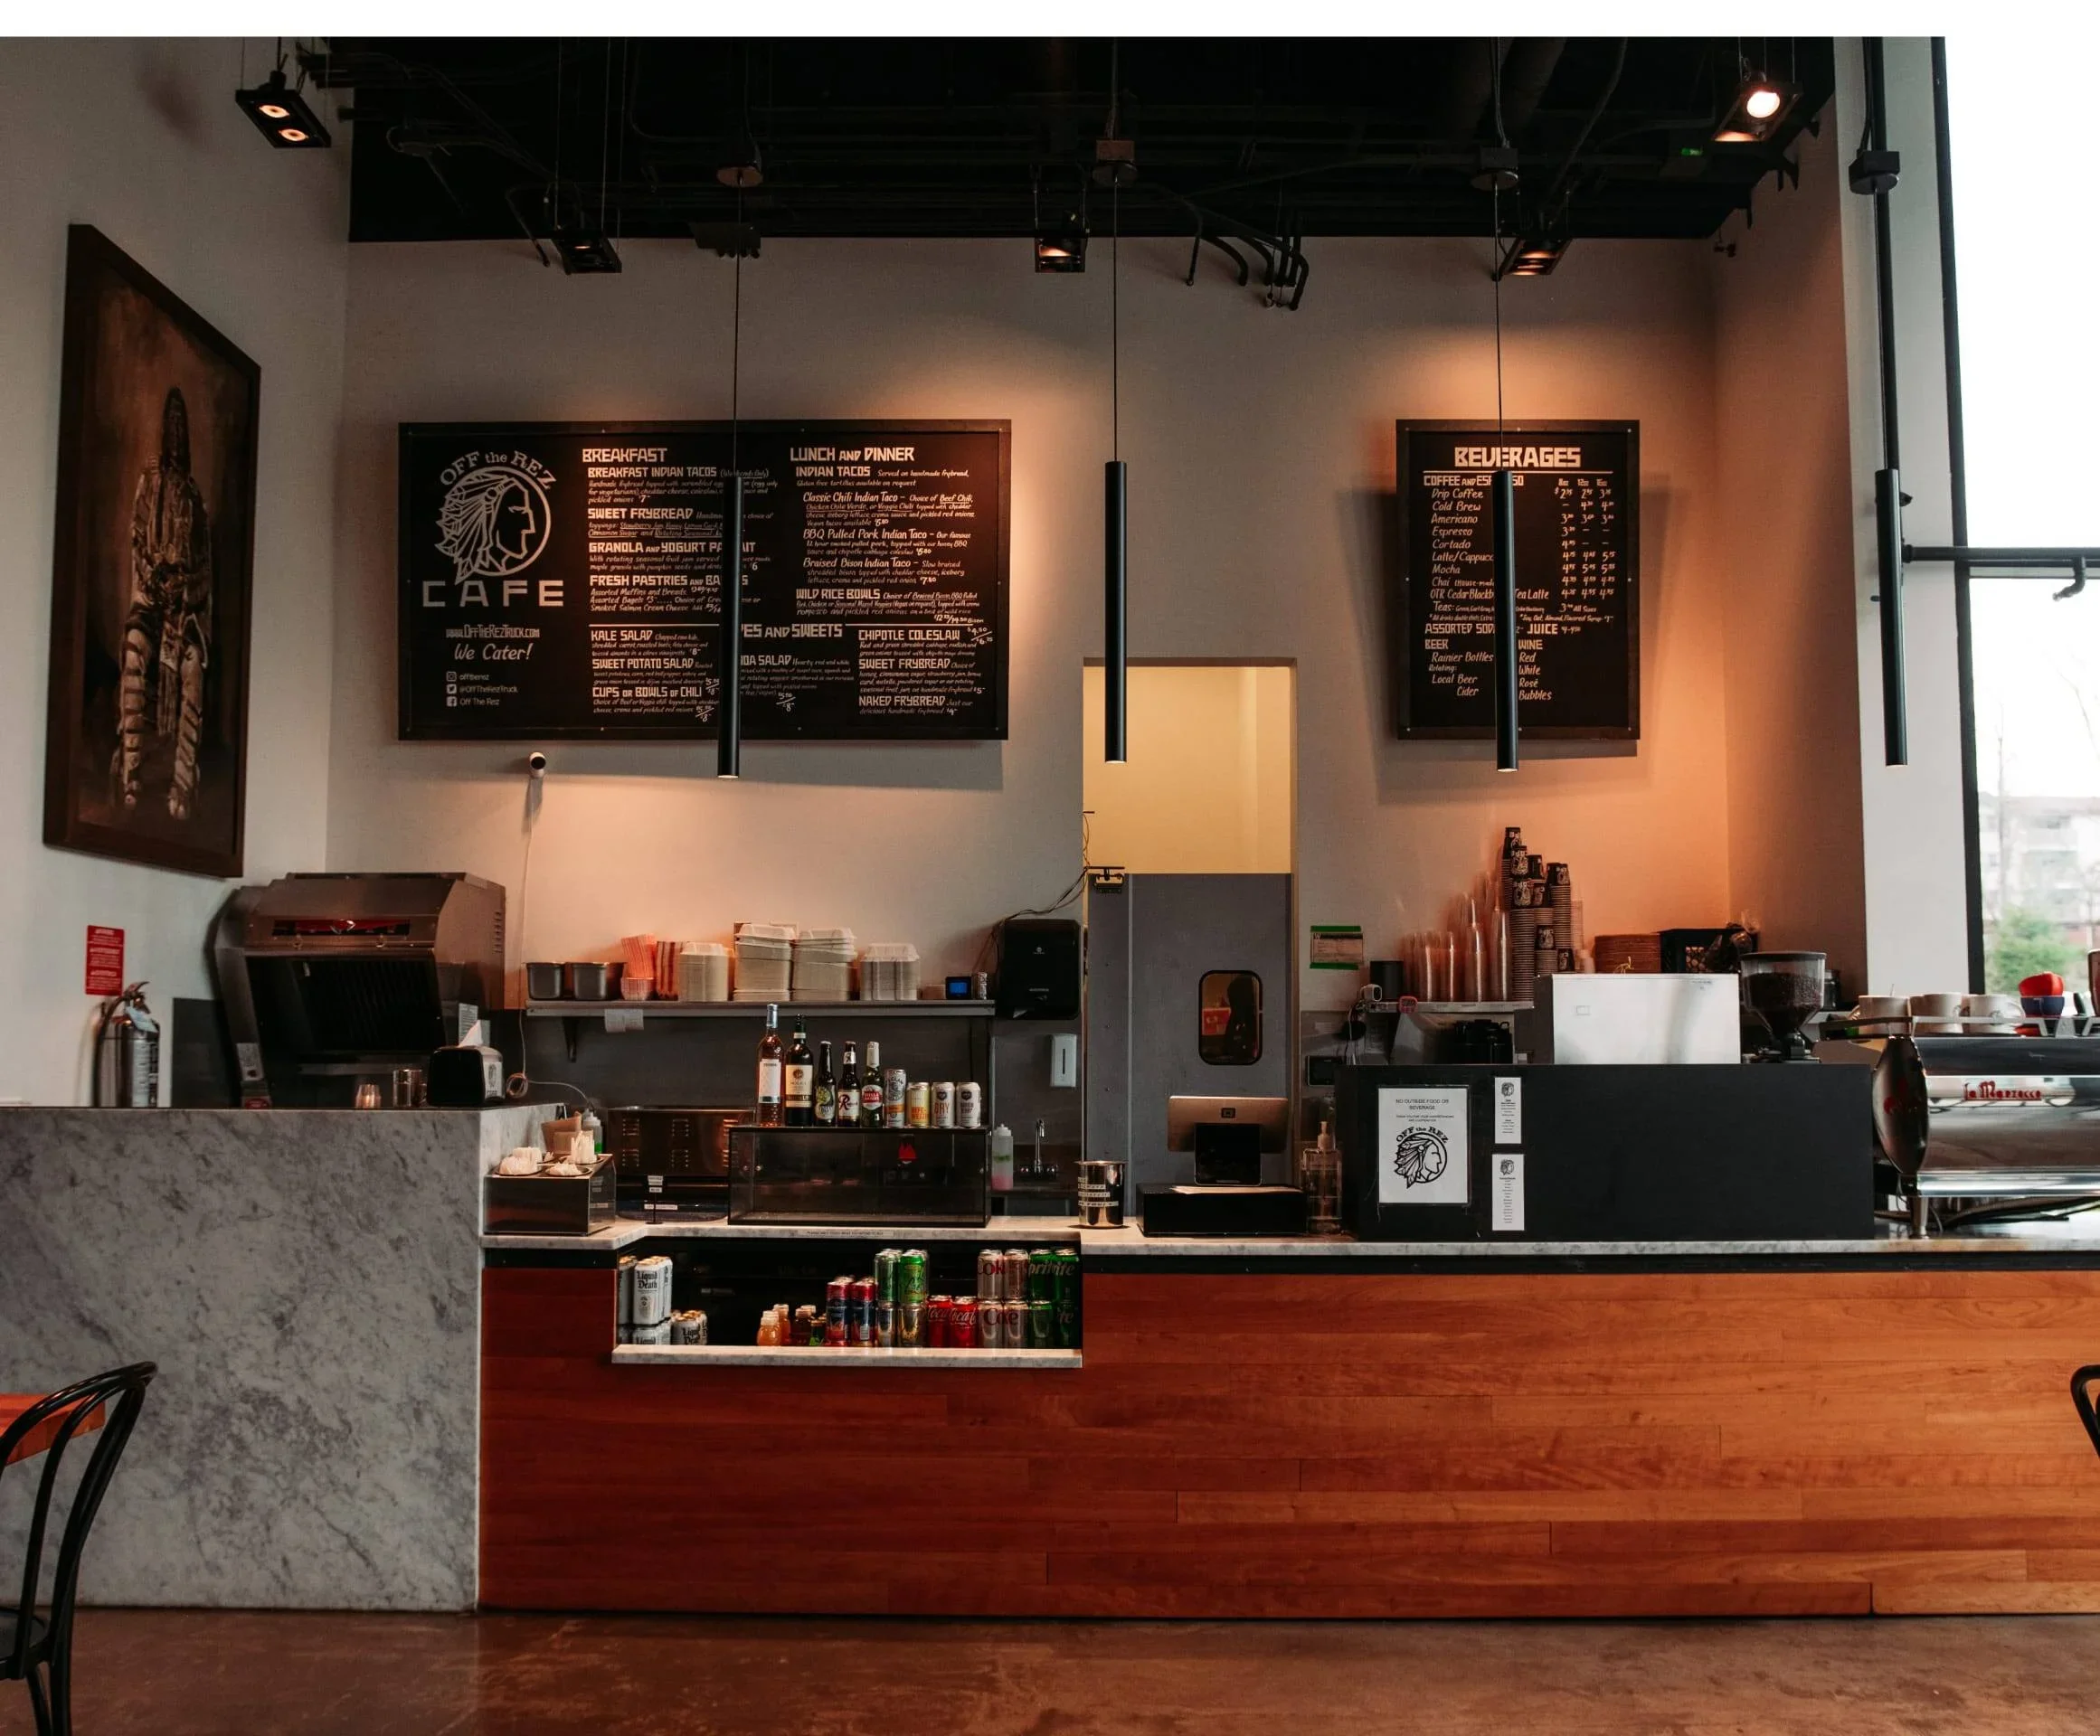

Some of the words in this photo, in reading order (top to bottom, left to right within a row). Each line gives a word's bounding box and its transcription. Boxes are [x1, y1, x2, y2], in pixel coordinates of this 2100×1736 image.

[582, 448, 667, 462] BREAKFAST
[790, 447, 835, 461] LUNCH
[839, 450, 861, 461] AND
[864, 447, 915, 461] DINNER
[1454, 447, 1581, 467] BEVERAGES
[440, 451, 479, 486] OFF
[484, 451, 507, 463] the
[510, 450, 557, 490] REZ
[588, 467, 648, 477] BREAKFAST
[651, 467, 684, 477] INDIAN
[686, 467, 717, 477] TACOS
[796, 466, 834, 476] INDIAN
[837, 466, 871, 476] TACOS
[877, 469, 900, 477] Served
[893, 479, 917, 488] request
[1424, 475, 1461, 486] COFFEE
[803, 491, 831, 502] Classic
[833, 491, 853, 502] Chili
[855, 491, 879, 502] Indian
[880, 490, 898, 503] Taco
[909, 494, 929, 502] Choice
[940, 494, 957, 503] Beef
[1432, 488, 1450, 500] Drip
[1452, 487, 1484, 498] Coffee
[1432, 501, 1452, 512] Cold
[1456, 501, 1481, 512] Brew
[588, 507, 628, 519] SWEET
[630, 507, 694, 519] FRYBREAD
[1431, 513, 1478, 524] Americano
[803, 528, 825, 540] BBQ
[828, 528, 855, 539] Pulled
[857, 529, 878, 540] Pork
[881, 527, 907, 539] Indian
[908, 528, 927, 539] Taco
[1432, 526, 1473, 539] Espresso
[589, 542, 643, 553] GRANOLA
[661, 542, 705, 553] YOGURT
[953, 541, 968, 549] BBQ
[1432, 538, 1471, 550] Cortado
[606, 554, 634, 564] rotating
[636, 553, 665, 562] seasonal
[803, 557, 837, 568] Braised
[840, 557, 862, 568] Bison
[864, 557, 890, 568] Indian
[891, 557, 912, 568] Taco
[922, 559, 936, 568] Slow
[1432, 563, 1461, 575] Mocha
[590, 574, 630, 586] FRESH
[632, 574, 688, 586] PASTRIES
[1432, 576, 1452, 588] Chai
[422, 580, 564, 608] CAFE
[591, 588, 620, 597] Assorted
[647, 588, 660, 597] and
[796, 588, 819, 599] WILD
[820, 588, 845, 599] RICE
[846, 588, 881, 599] BOWLS
[883, 591, 903, 599] Choice
[1430, 589, 1445, 600] OTR
[1447, 588, 1470, 600] Cedar
[1469, 588, 1494, 599] Blackb
[1528, 588, 1550, 600] Latte
[590, 596, 620, 606] Assorted
[621, 596, 644, 607] Bagels
[1433, 600, 1455, 612] Teas:
[590, 604, 617, 612] Smoked
[619, 604, 642, 614] Salmon
[643, 604, 666, 613] Cream
[1574, 604, 1583, 613] All
[764, 626, 791, 638] AND
[791, 623, 843, 637] SWEETS
[1424, 622, 1473, 634] ASSORTED
[1475, 622, 1495, 634] SOD
[1527, 623, 1558, 635] JUICE
[591, 629, 617, 642] KALE
[620, 629, 653, 642] SALAD
[858, 629, 904, 641] CHIPOTLE
[908, 629, 960, 641] COLESLAW
[1424, 638, 1449, 650] BEER
[1518, 639, 1544, 650] WINE
[454, 643, 476, 660] We
[482, 643, 534, 660] Cater!
[1432, 651, 1463, 663] Rainier
[1464, 651, 1494, 663] Bottles
[1518, 652, 1537, 663] Red
[592, 658, 626, 669] SWEET
[627, 658, 661, 669] POTATO
[663, 658, 695, 669] SALAD
[758, 655, 793, 666] SALAD
[858, 658, 895, 669] SWEET
[898, 658, 951, 669] FRYBREAD
[1518, 665, 1541, 675] White
[1432, 674, 1455, 684] Local
[1457, 673, 1479, 684] Beer
[592, 686, 620, 698] CUPS
[622, 689, 633, 698] OR
[634, 686, 668, 698] BOWLS
[669, 689, 680, 698] OF
[680, 686, 703, 698] CHILI
[1457, 685, 1480, 697] Cider
[1518, 689, 1553, 702] Bubbles
[858, 695, 892, 706] NAKED
[894, 695, 946, 706] FRYBREAD
[1395, 1126, 1414, 1143] OFF
[1428, 1126, 1450, 1144] REZ
[637, 1270, 658, 1282] Liquid
[637, 1279, 658, 1289] Death
